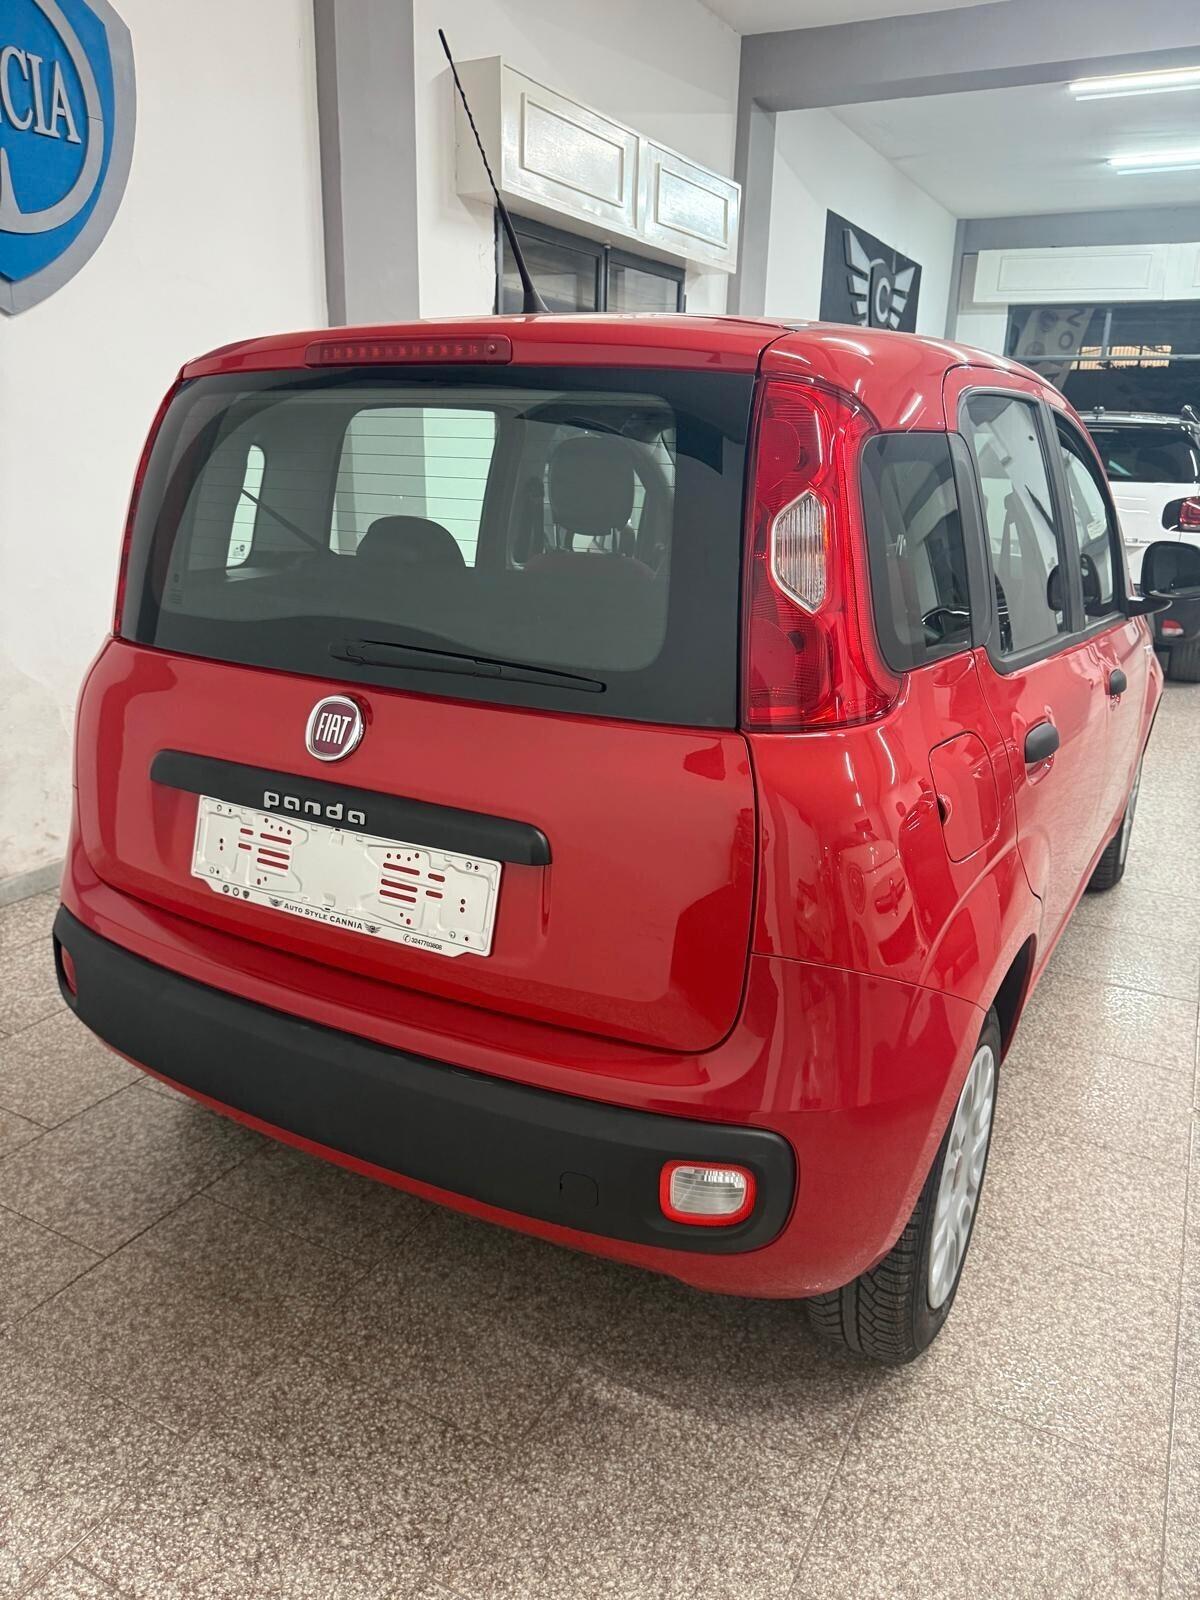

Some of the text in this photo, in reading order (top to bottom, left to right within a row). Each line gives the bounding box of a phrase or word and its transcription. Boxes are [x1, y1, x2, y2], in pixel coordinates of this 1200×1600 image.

[0, 46, 82, 143] CIA
[315, 712, 352, 745] FIAT
[263, 791, 366, 825] panda
[284, 902, 363, 930] AUTO STYLE CANNIA
